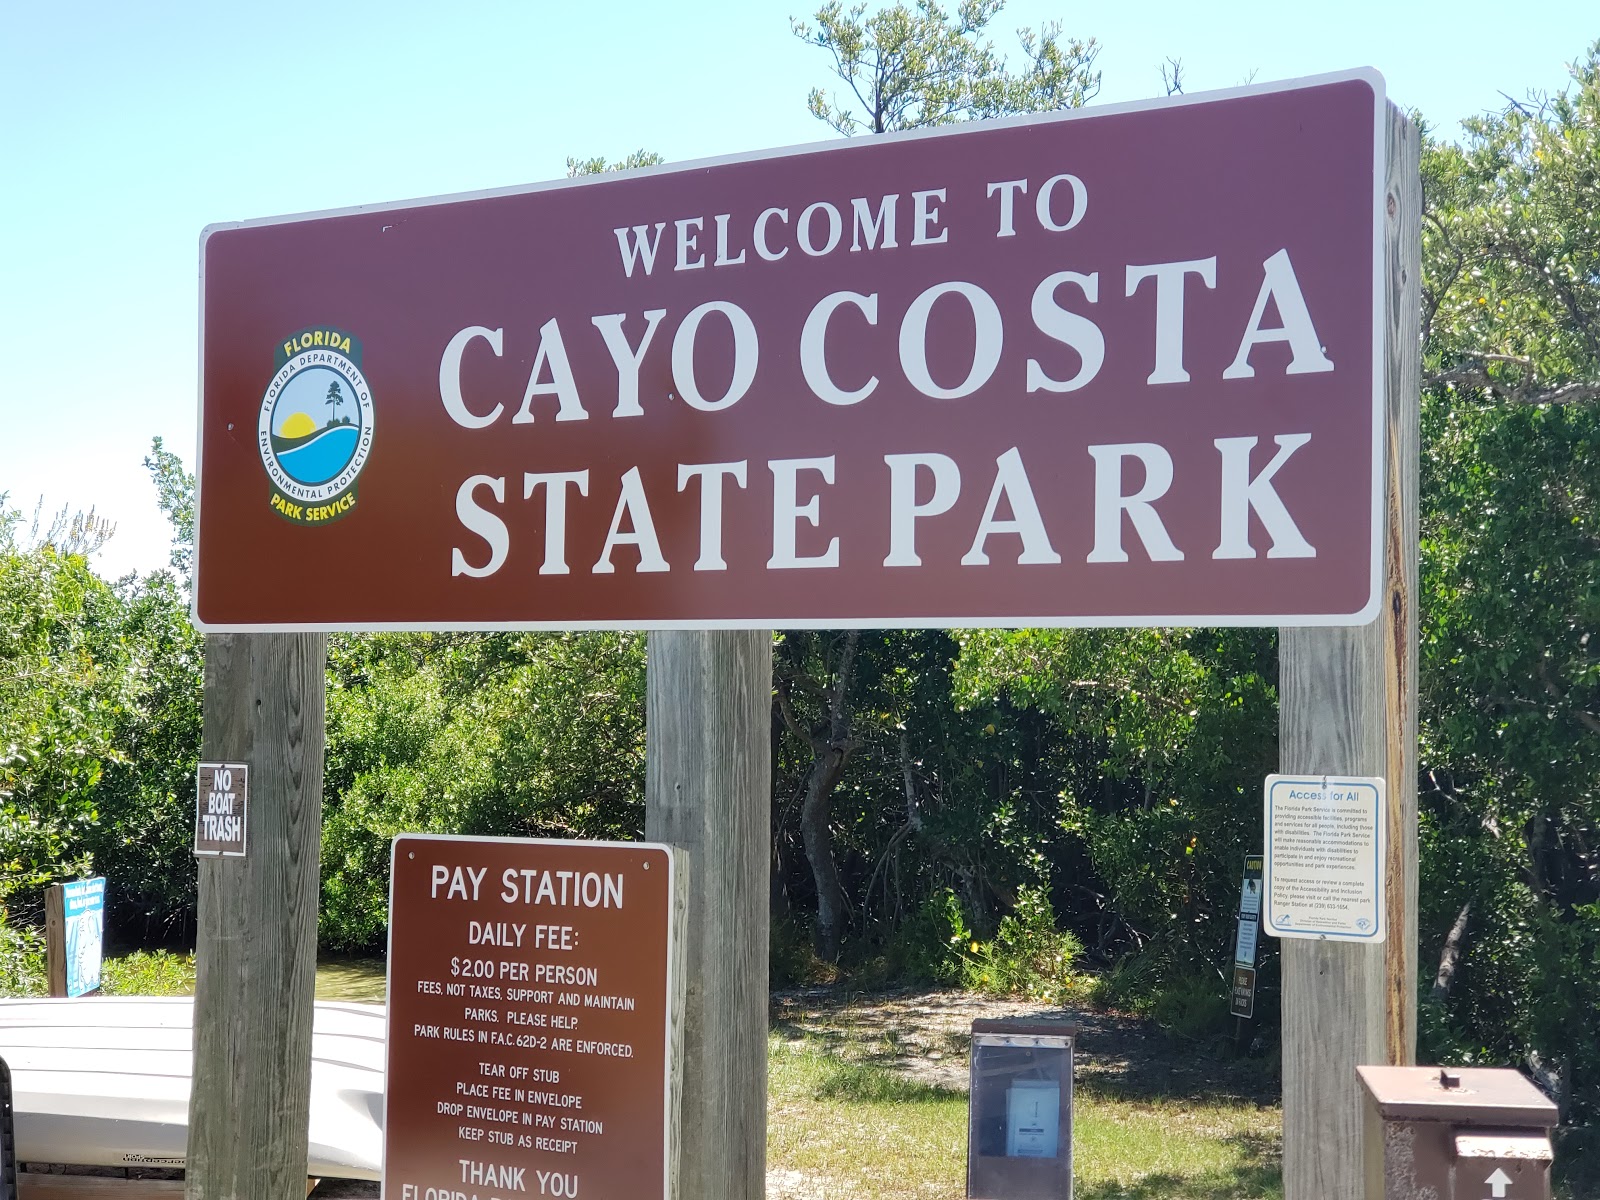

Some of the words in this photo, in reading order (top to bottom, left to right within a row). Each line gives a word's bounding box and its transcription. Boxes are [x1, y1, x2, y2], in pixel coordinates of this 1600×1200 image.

[613, 188, 948, 278] WELCOME
[987, 173, 1088, 237] TO
[284, 331, 350, 357] FLORIDA
[439, 301, 759, 429] CAYO
[800, 248, 1335, 406] COSTA
[264, 364, 295, 412] FLORIDA
[300, 354, 363, 386] DEPARTMENT
[361, 392, 369, 408] OF
[261, 431, 322, 498] ENVIRONMENTAL
[328, 426, 371, 495] PROTECTION
[270, 493, 303, 520] PARK
[306, 492, 355, 521] SERVICE
[452, 454, 840, 578] STATE
[883, 432, 1317, 567] PARK
[214, 770, 231, 791] NO
[209, 793, 235, 814] BOAT
[1289, 790, 1326, 800] Access
[1330, 791, 1343, 800] for
[1346, 792, 1359, 801] All
[203, 815, 240, 841] TRASH
[431, 865, 487, 901] PAY
[501, 868, 623, 909] STATION
[1300, 886, 1329, 894] Accessibility
[468, 921, 526, 946] DAILY
[535, 924, 579, 950] FEE:
[451, 957, 494, 979] $2.00
[500, 962, 528, 982] PER
[536, 964, 597, 986] PERSON
[418, 980, 443, 995] FEES,
[446, 983, 465, 997] NOT
[507, 988, 553, 1004] SUPPORT
[558, 993, 580, 1006] AND
[584, 995, 635, 1011] MAINTAIN
[464, 1008, 499, 1023] PARKS.
[507, 1012, 547, 1027] PLEASE
[551, 1016, 578, 1030] HELP.
[414, 1024, 440, 1038] PARK
[443, 1027, 475, 1042] RULES
[478, 1030, 487, 1043] IN
[551, 1039, 572, 1052] ARE
[577, 1042, 634, 1058] ENFORCED.
[479, 1062, 505, 1077] TEAR
[509, 1066, 529, 1080] OFF
[533, 1069, 560, 1083] STUB
[456, 1082, 489, 1098] PLACE
[492, 1087, 511, 1100] FEE
[515, 1088, 524, 1101] IN
[528, 1091, 582, 1109] ENVELOPE
[437, 1101, 463, 1116] DROP
[467, 1105, 518, 1123] ENVELOPE
[522, 1111, 532, 1124] IN
[536, 1114, 555, 1129] PAY
[561, 1118, 603, 1135] STATION
[459, 1127, 484, 1142] KEEP
[488, 1130, 514, 1145] STUB
[518, 1135, 532, 1148] AS
[536, 1137, 577, 1154] RECEIPT
[459, 1159, 526, 1192] THANK
[536, 1170, 578, 1199] YOU
